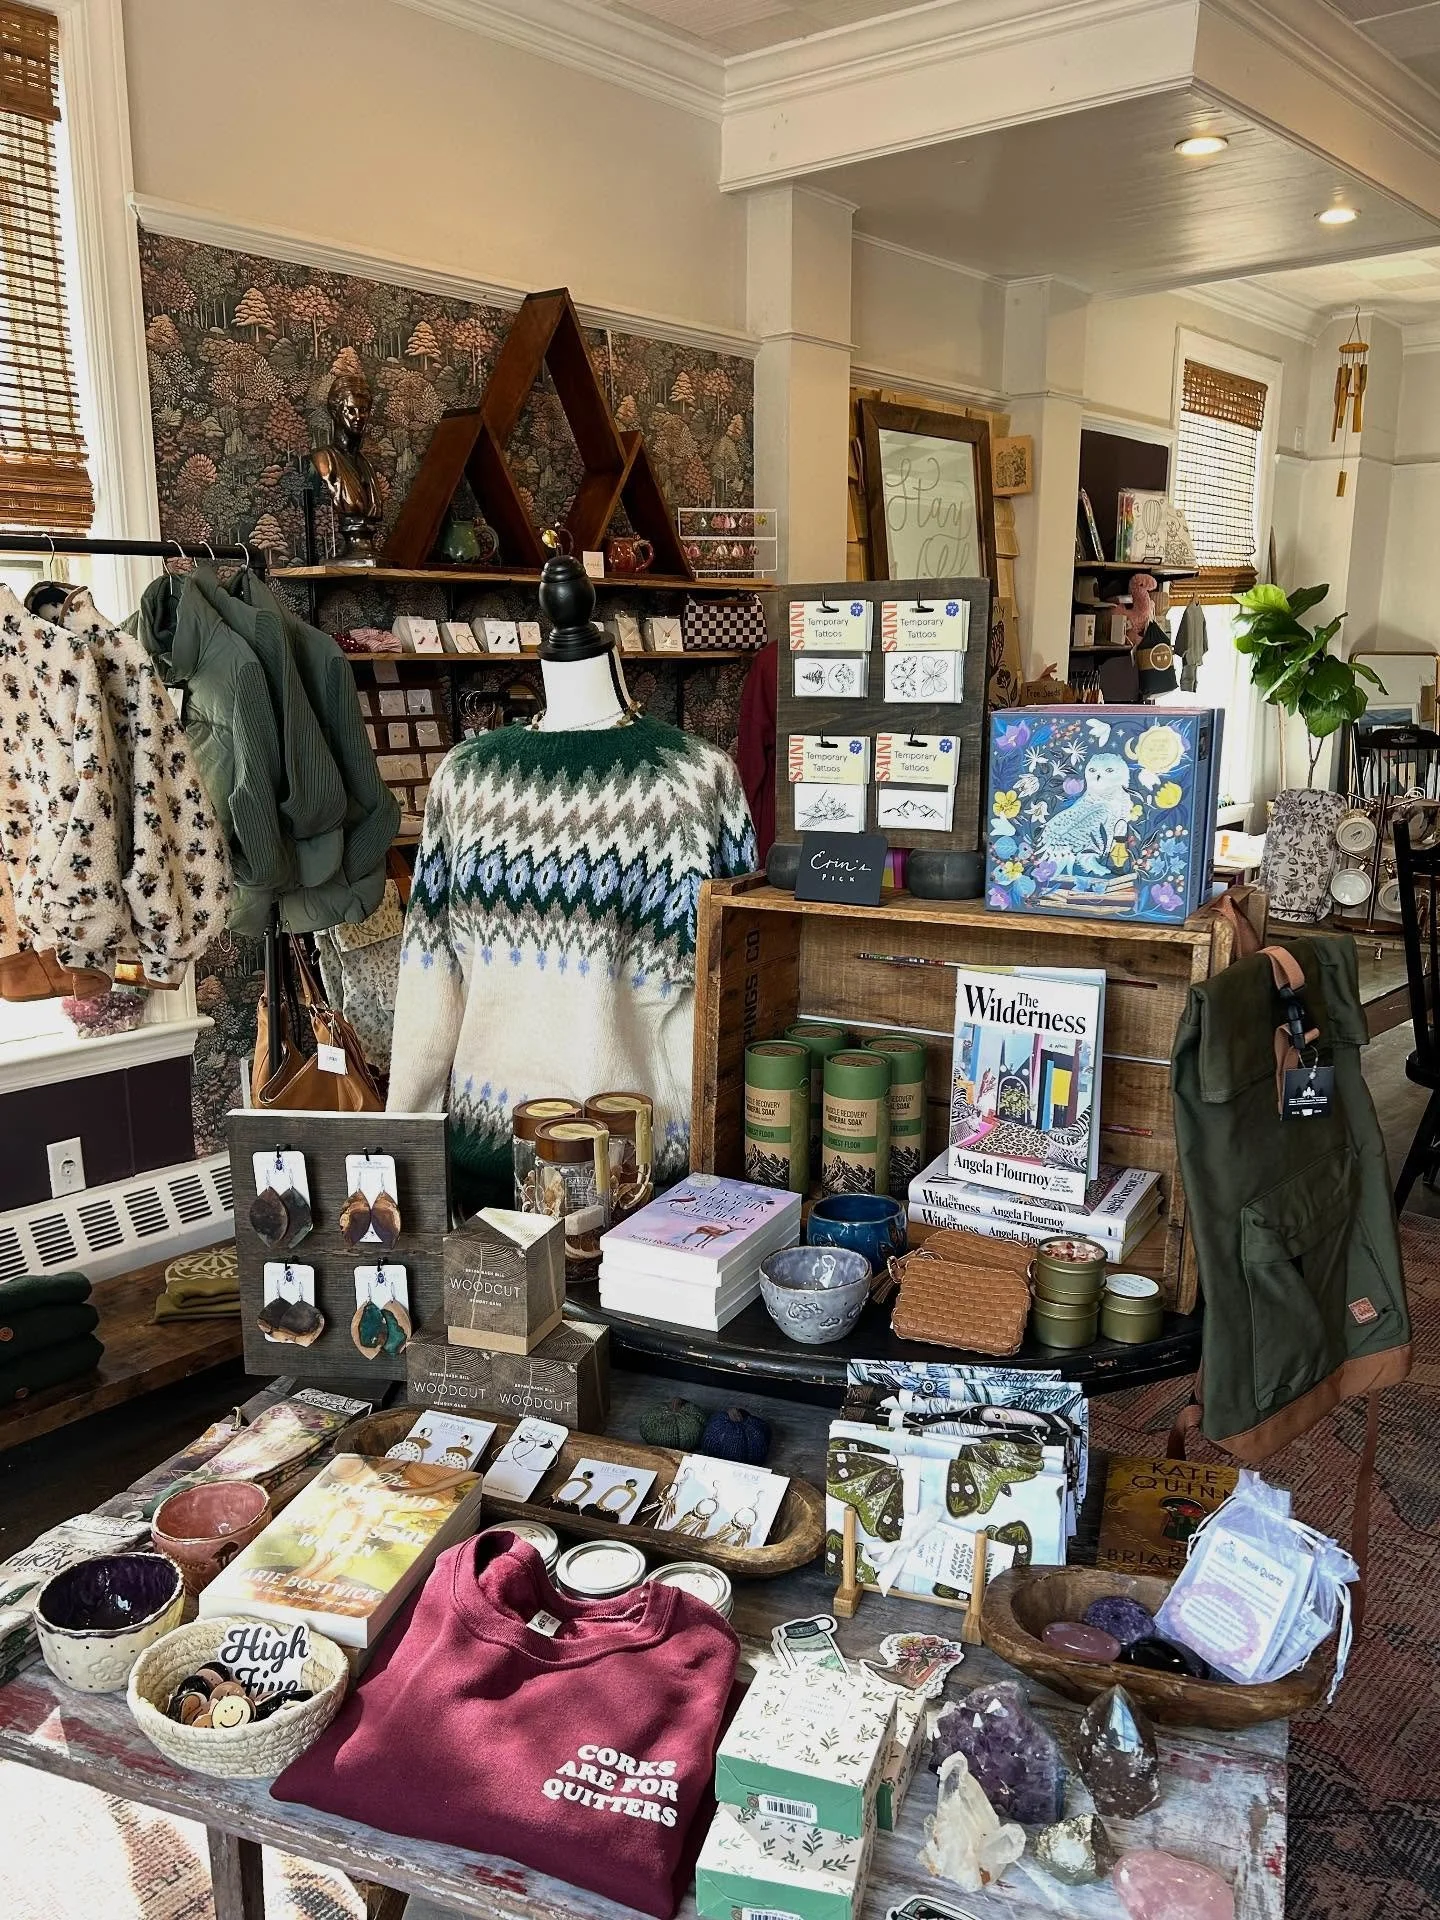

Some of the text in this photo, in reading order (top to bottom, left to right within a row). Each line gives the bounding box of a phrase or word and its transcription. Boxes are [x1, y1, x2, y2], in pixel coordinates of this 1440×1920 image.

[884, 457, 972, 541] Stay
[808, 618, 849, 626] Temporary
[900, 618, 944, 627] Temporary
[815, 630, 842, 638] Tattoos
[907, 630, 937, 639] Tattoos
[806, 751, 848, 763] Temporary
[894, 750, 938, 762] Temporary
[812, 763, 841, 773] Tattoos
[900, 762, 930, 773] Tattoos
[810, 850, 872, 872] Erin's
[821, 873, 855, 882] PICK
[963, 983, 1086, 1035] Wilderness
[1017, 992, 1039, 1009] The
[841, 1108, 868, 1119] RECOVERY
[848, 1118, 863, 1126] SOAK
[953, 1153, 993, 1176] Angela
[995, 1162, 1051, 1190] Flournoy
[948, 1193, 959, 1203] The
[922, 1188, 1065, 1230] Wilderness Angela Flournoy
[947, 1213, 958, 1223] The
[921, 1208, 1041, 1245] Wilderness Angela Flou
[449, 1277, 521, 1299] WOODCUT
[413, 1381, 487, 1400] WOODCUT
[499, 1393, 572, 1413] WOODCUT
[377, 1471, 411, 1488] The
[1151, 1461, 1218, 1484] KATE
[5, 1553, 73, 1571] HIKIN
[1107, 1547, 1181, 1570] BRIAR
[1242, 1555, 1285, 1588] Rose Quartz
[284, 1575, 384, 1602] BOSTWICK
[220, 1625, 309, 1674] High
[234, 1666, 299, 1698] Five
[577, 1744, 678, 1777] CORKS
[555, 1760, 679, 1802] ARE FOR
[541, 1778, 679, 1828] QUITTERS
